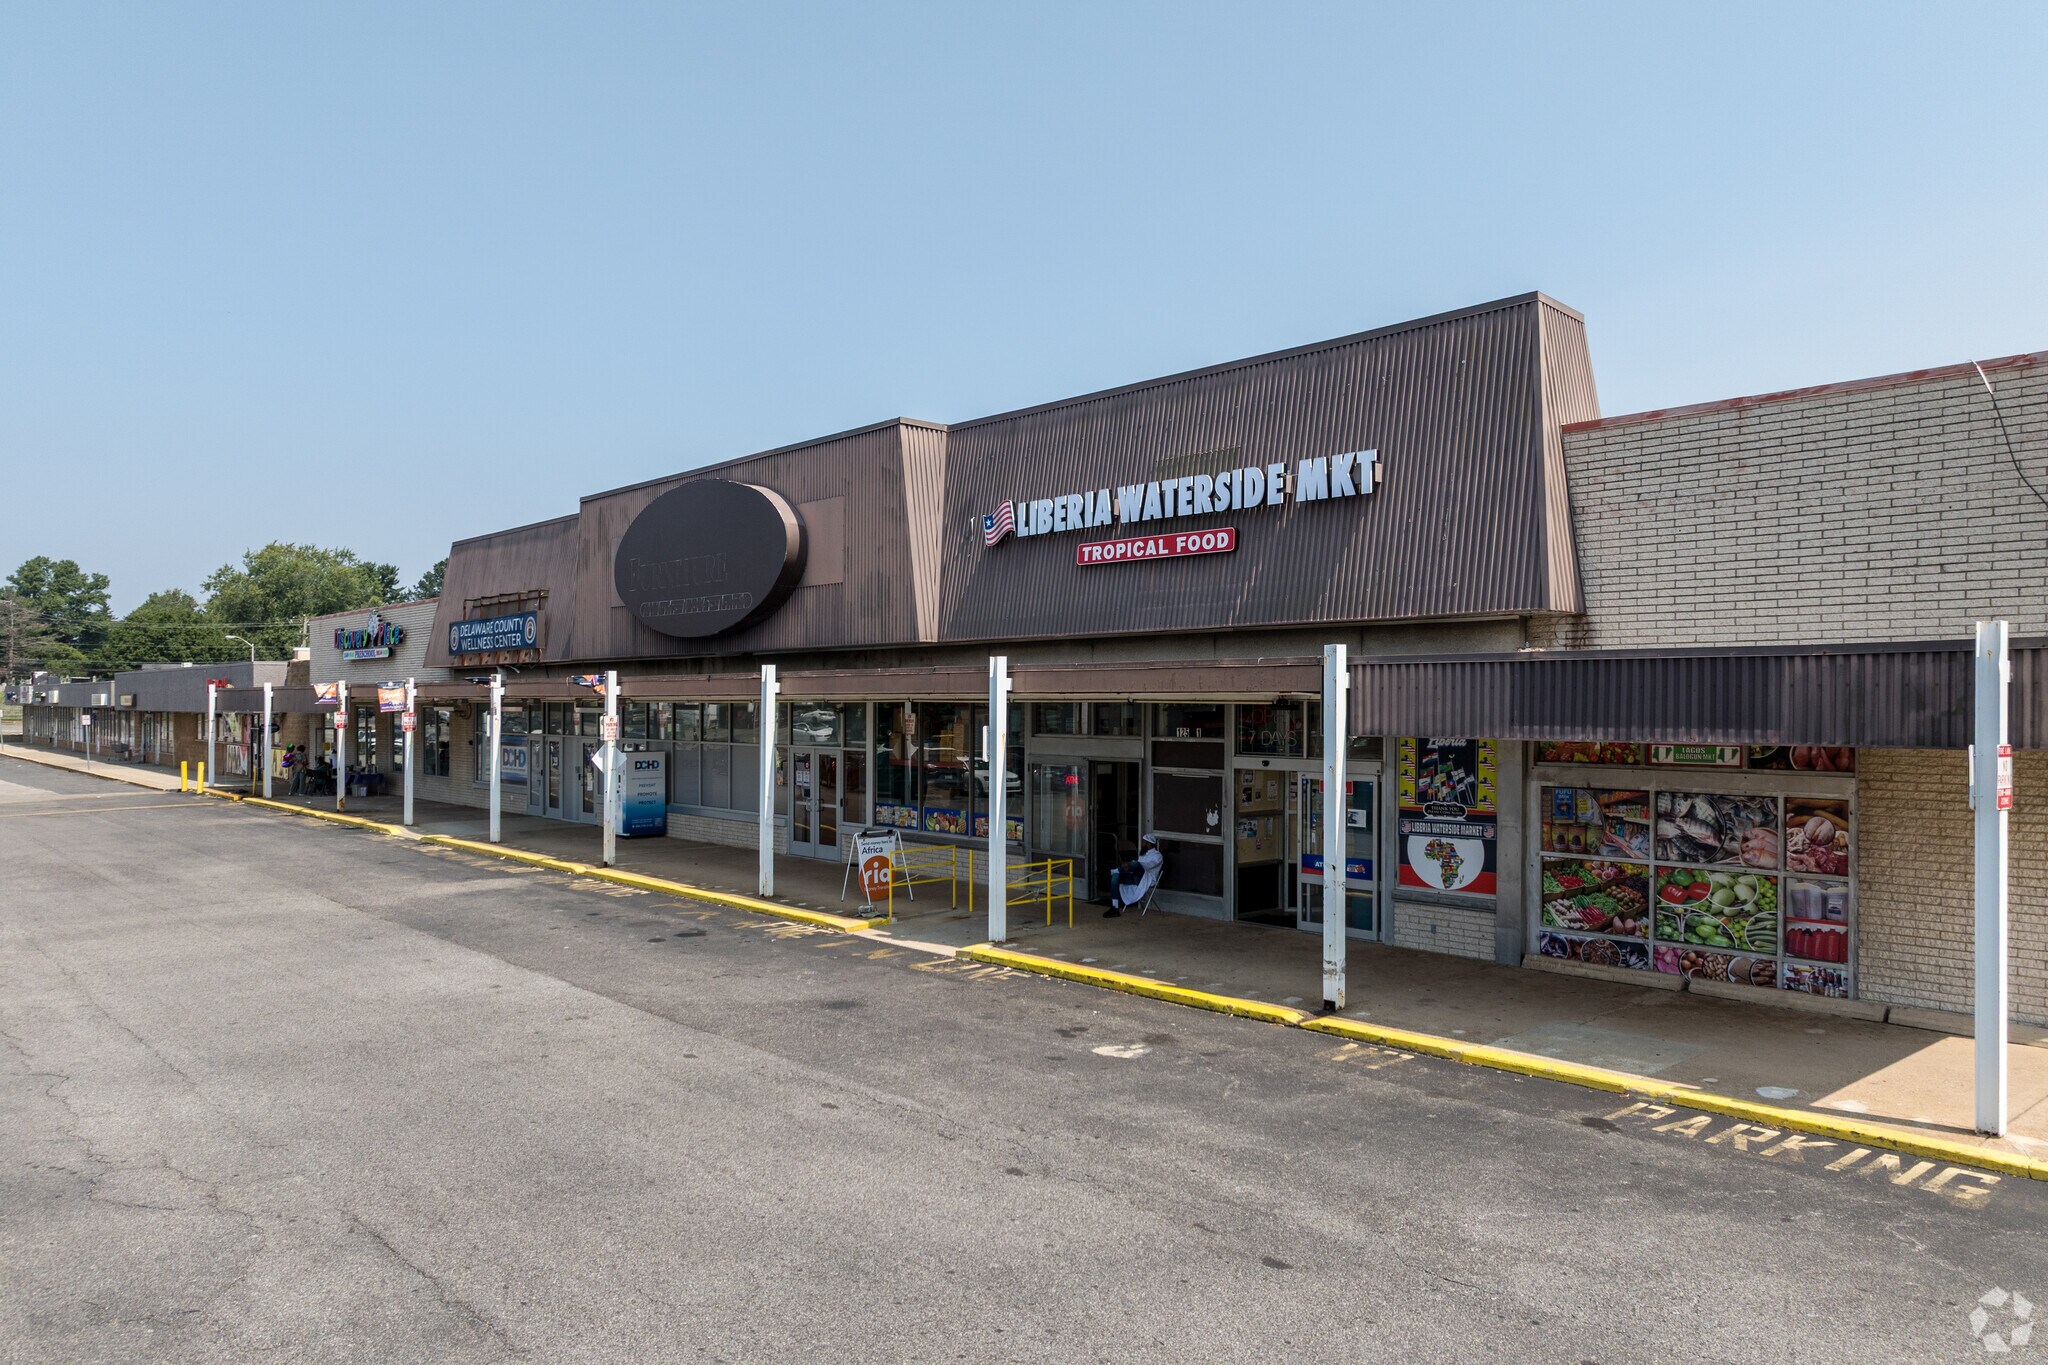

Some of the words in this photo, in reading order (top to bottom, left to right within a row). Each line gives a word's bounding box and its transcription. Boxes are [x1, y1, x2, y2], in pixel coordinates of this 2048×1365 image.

[1016, 488, 1113, 538] LIBERIA
[1117, 462, 1286, 524] WATERSIDE
[1296, 448, 1379, 502] MKT
[1082, 538, 1169, 562] TROPICAL
[1176, 531, 1230, 554] FOOD
[334, 627, 368, 650] Discovery
[378, 622, 400, 646] Place
[460, 621, 494, 637] DELAWARE
[494, 617, 524, 633] COUNTY
[460, 635, 493, 651] WELLNESS
[494, 633, 522, 648] CENTER
[1176, 727, 1190, 738] 125
[1248, 730, 1256, 745] 7
[1261, 730, 1298, 747] DAYS
[502, 748, 527, 768] DCHD
[634, 760, 660, 770] DCHD
[1411, 822, 1431, 833] LIBERIA
[1431, 823, 1460, 835] WATERSIDE
[1460, 824, 1483, 837] MARKET
[861, 846, 884, 855] Africa
[864, 861, 890, 885] ria
[1602, 1102, 2002, 1201] PARKING
